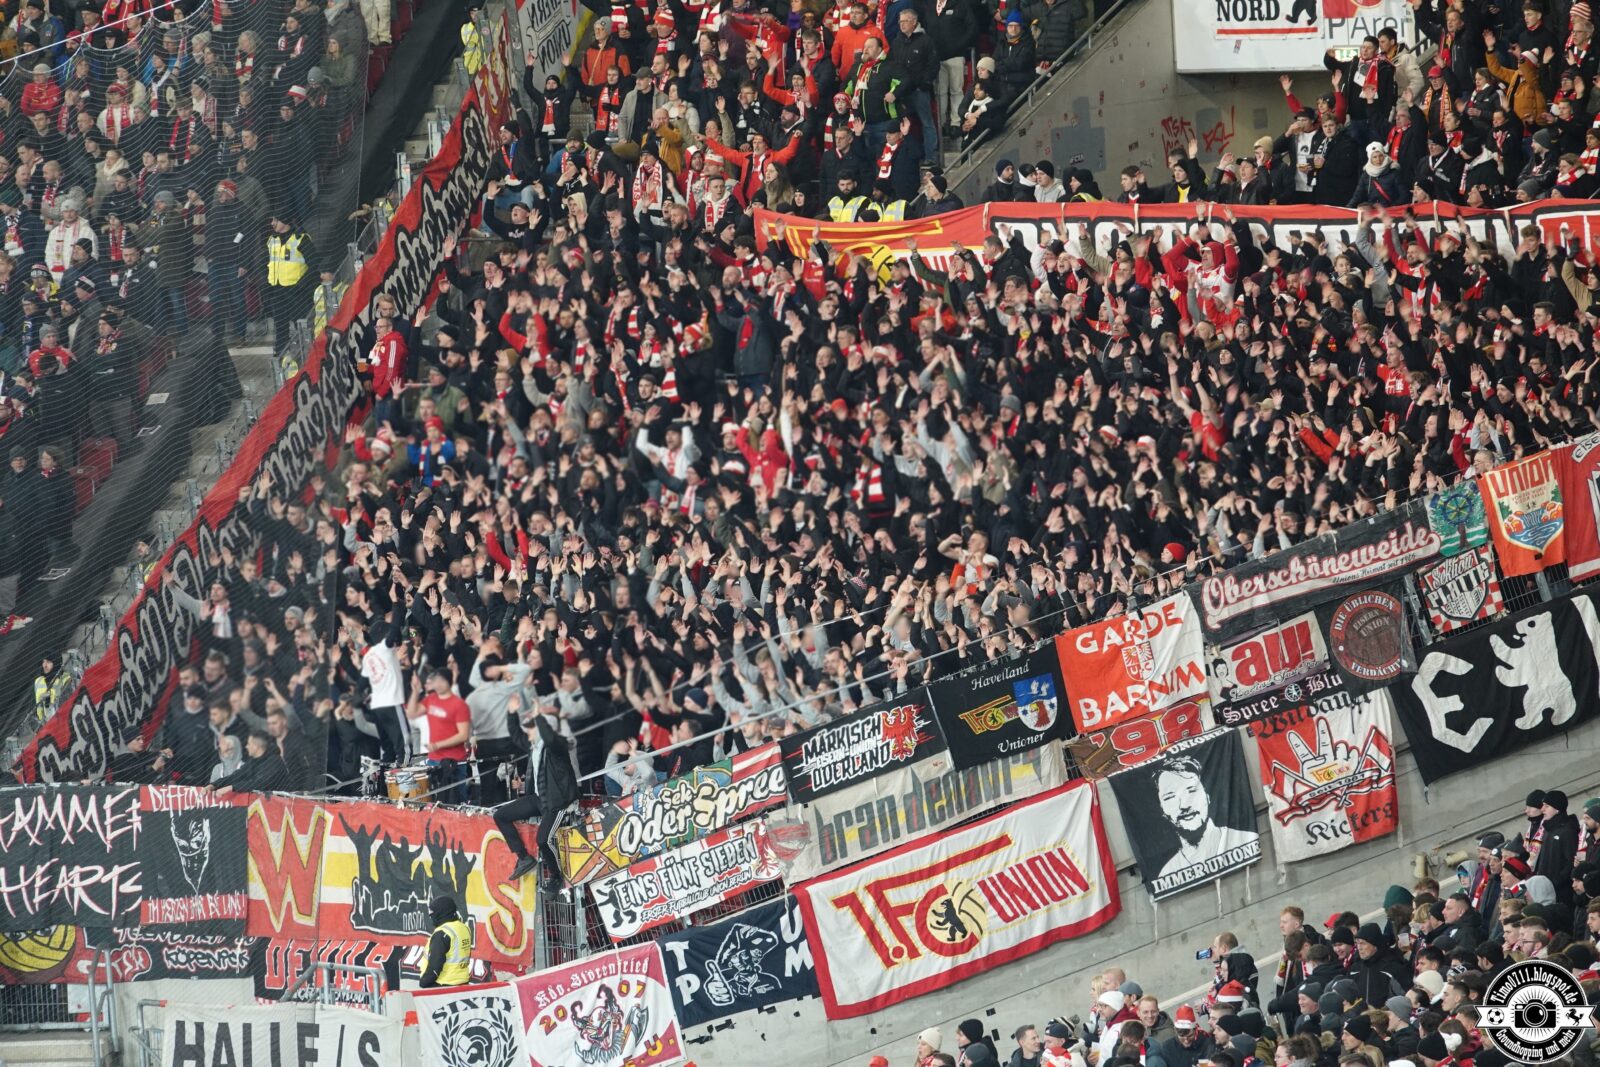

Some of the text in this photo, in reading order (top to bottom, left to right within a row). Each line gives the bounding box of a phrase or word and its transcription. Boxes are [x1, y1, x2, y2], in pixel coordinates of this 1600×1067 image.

[1216, 0, 1280, 22] NORD
[1202, 520, 1429, 618] Oberschöneweide
[1427, 562, 1491, 608] PLATTE
[1075, 602, 1184, 653] GARDE
[1334, 594, 1395, 632] DIE ÜBLICHEN
[1360, 616, 1391, 638] UNION
[971, 659, 1030, 691] Havelland
[1078, 661, 1206, 728] BARNIM
[1222, 695, 1280, 724] Spree
[802, 713, 882, 766] MÄRKISCH
[998, 733, 1045, 753] Unioner
[811, 741, 892, 792] ODERLAND
[618, 763, 787, 857] Oder Spree
[616, 833, 759, 911] EINS FÜNF SIEBEN
[977, 847, 1090, 924] UNION
[1153, 840, 1261, 894] IMMER UNIONE
[569, 956, 649, 988] Störenfried
[432, 997, 515, 1024] SIXTY
[539, 982, 646, 1035] 20 07
